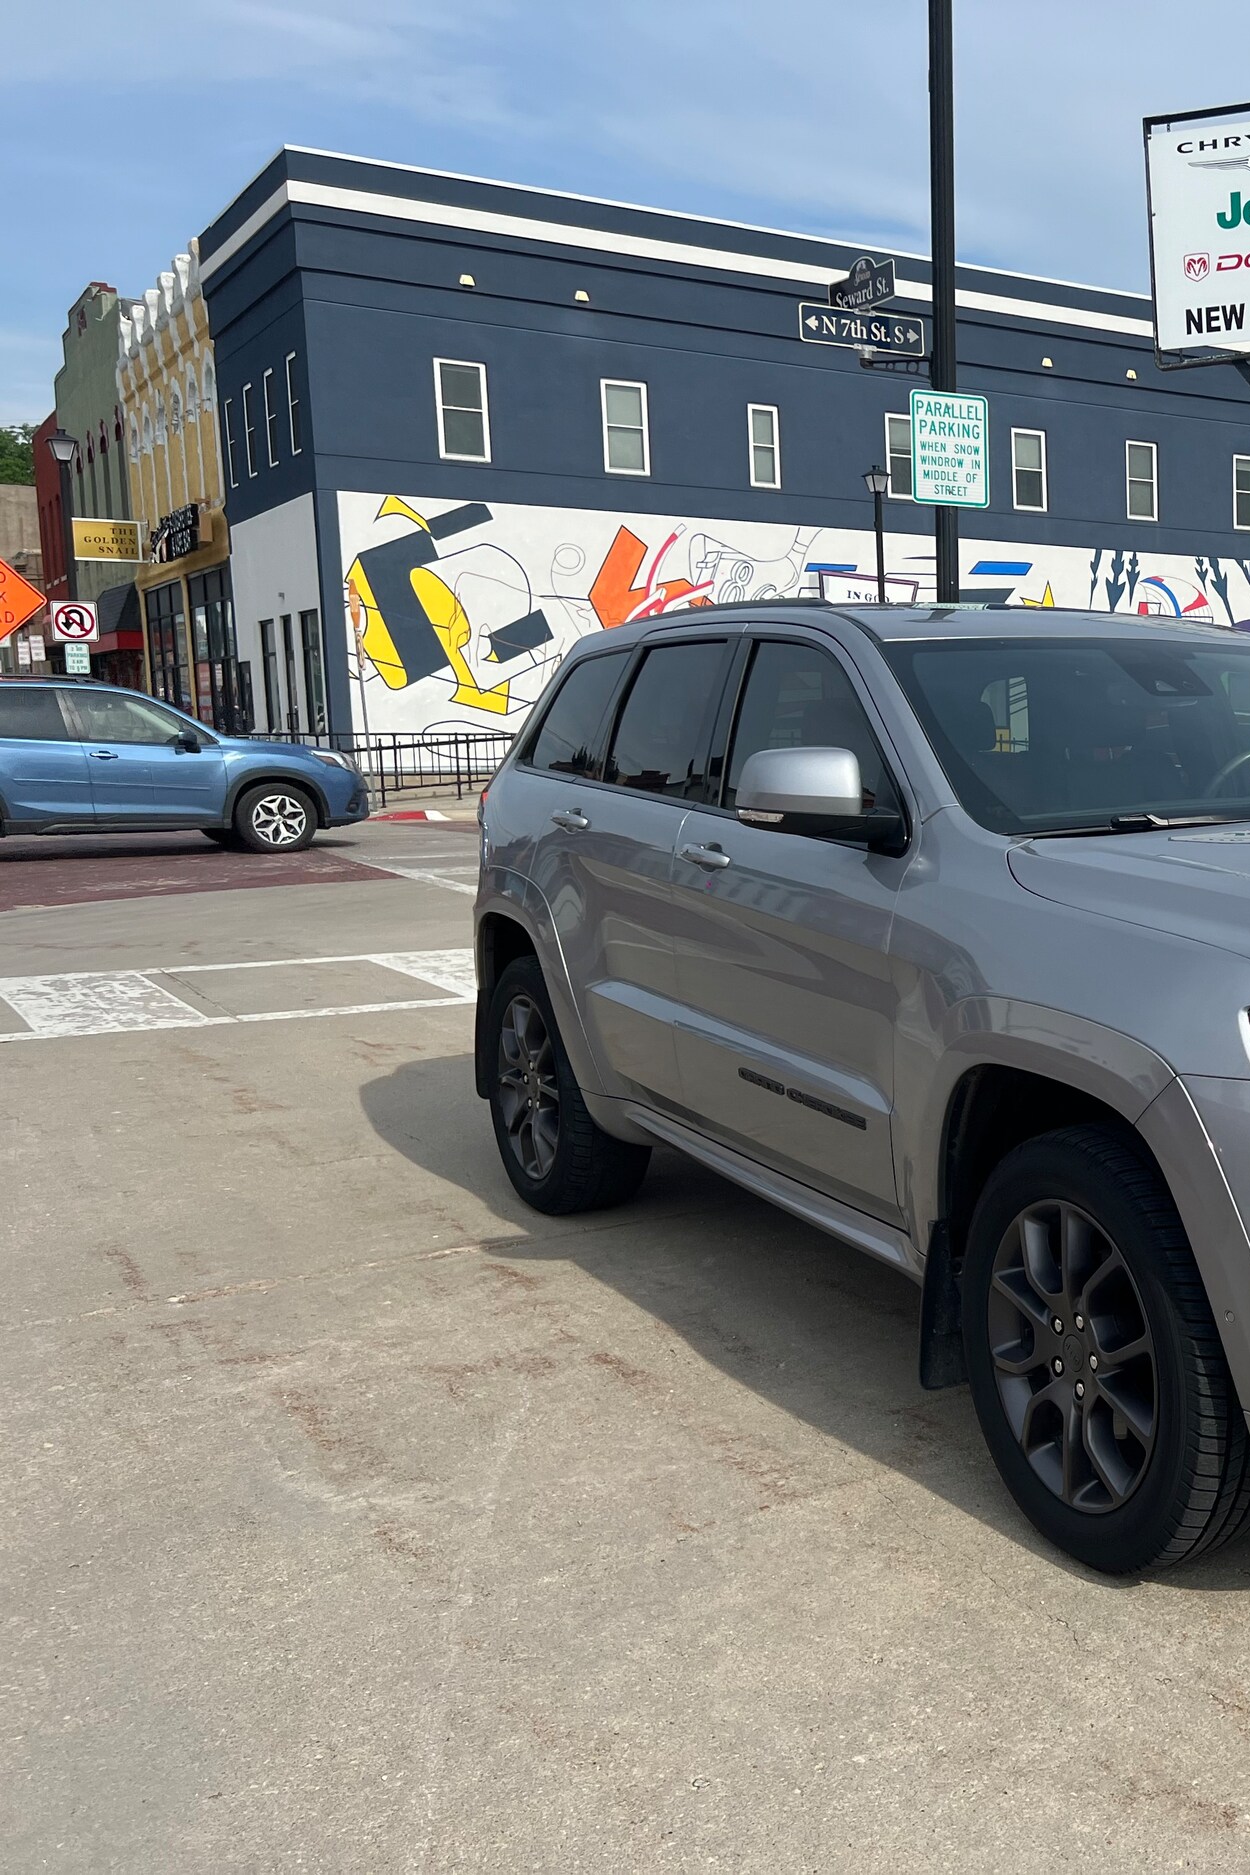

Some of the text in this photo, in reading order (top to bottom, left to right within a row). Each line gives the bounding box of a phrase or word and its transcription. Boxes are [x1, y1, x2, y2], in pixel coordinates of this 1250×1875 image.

[836, 280, 873, 308] Seward
[876, 277, 889, 297] St.
[1185, 302, 1245, 335] NEW
[821, 315, 904, 344] N 7th St. S
[916, 399, 982, 421] PARALLEL
[919, 419, 980, 440] PARKING
[920, 441, 980, 456] WHEN SNOW
[920, 455, 981, 470] WINDROW IN
[923, 469, 978, 483] MIDDLE OF
[934, 484, 968, 497] STREET
[109, 527, 137, 536] THE
[84, 535, 137, 545] GOLDEN
[98, 546, 138, 555] SNAIL
[847, 590, 861, 600] IN
